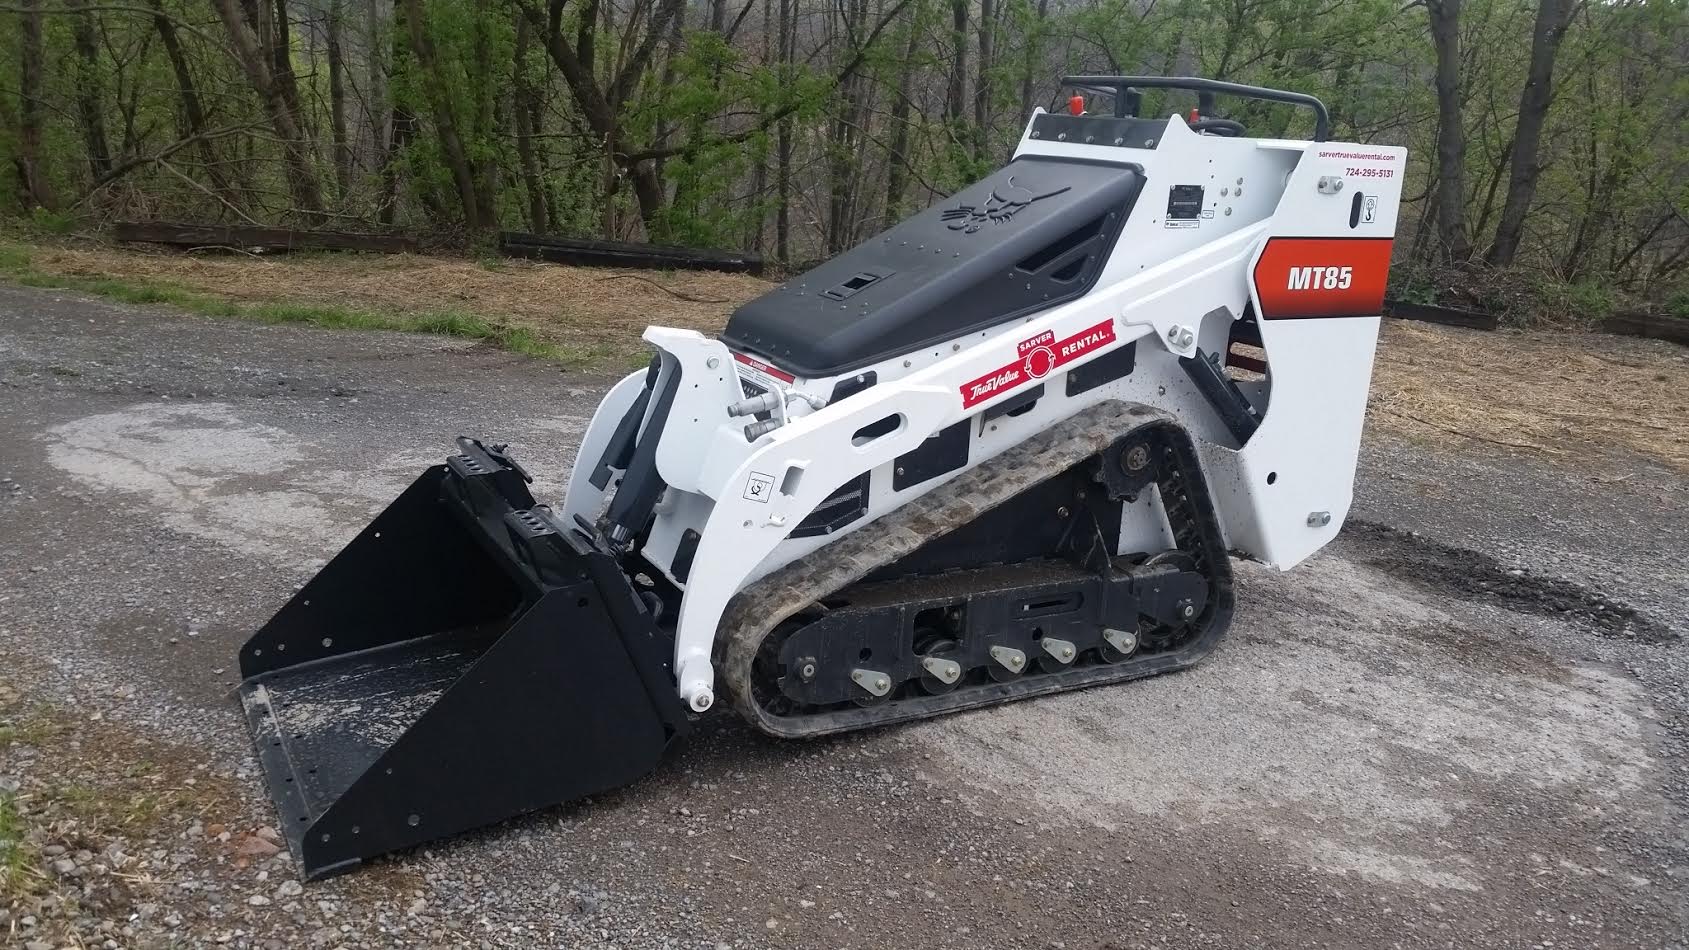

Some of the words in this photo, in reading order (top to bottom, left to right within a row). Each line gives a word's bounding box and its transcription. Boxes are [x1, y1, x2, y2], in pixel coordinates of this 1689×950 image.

[1319, 151, 1396, 161] sarvertruevaluerental.com
[1345, 168, 1394, 178] 724-295-5131
[1287, 266, 1353, 290] MT85
[1019, 333, 1052, 352] SARVER
